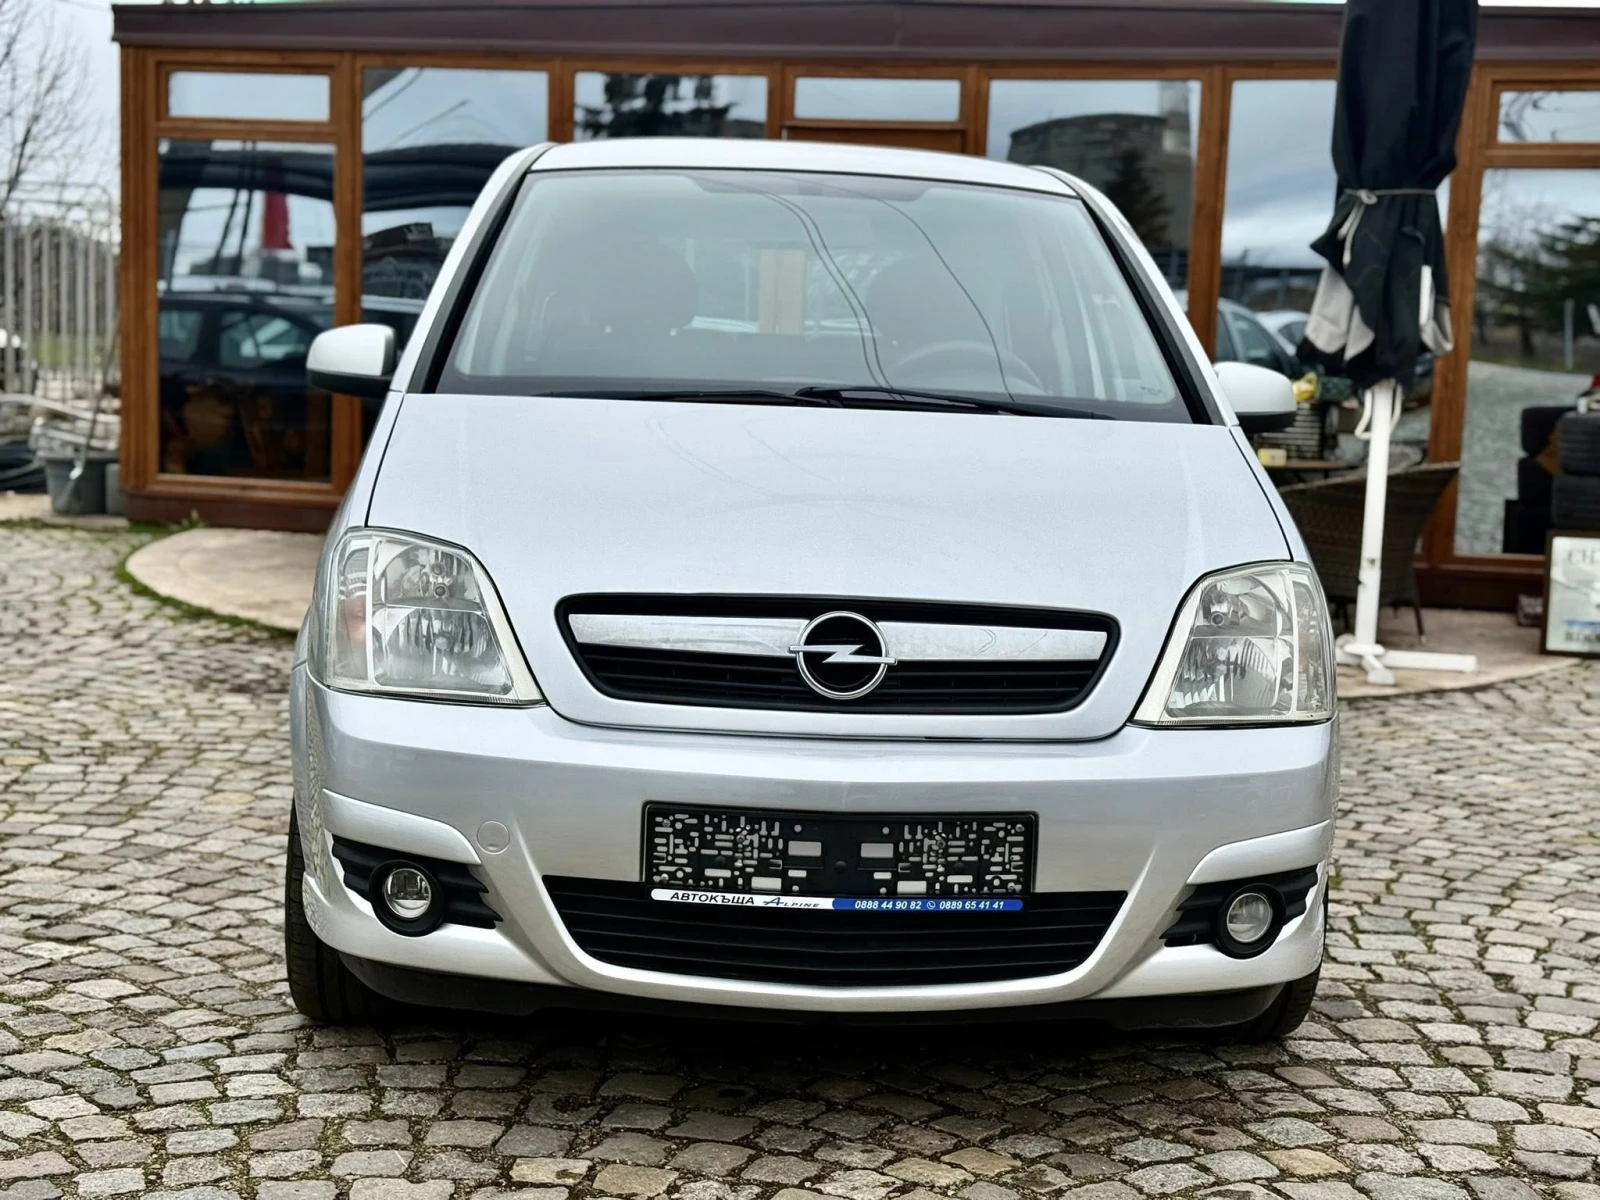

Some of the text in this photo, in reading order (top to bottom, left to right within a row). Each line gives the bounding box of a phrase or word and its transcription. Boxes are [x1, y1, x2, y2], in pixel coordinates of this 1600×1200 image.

[855, 900, 1005, 910] 0888 44 90 82 0889 65 41 41
